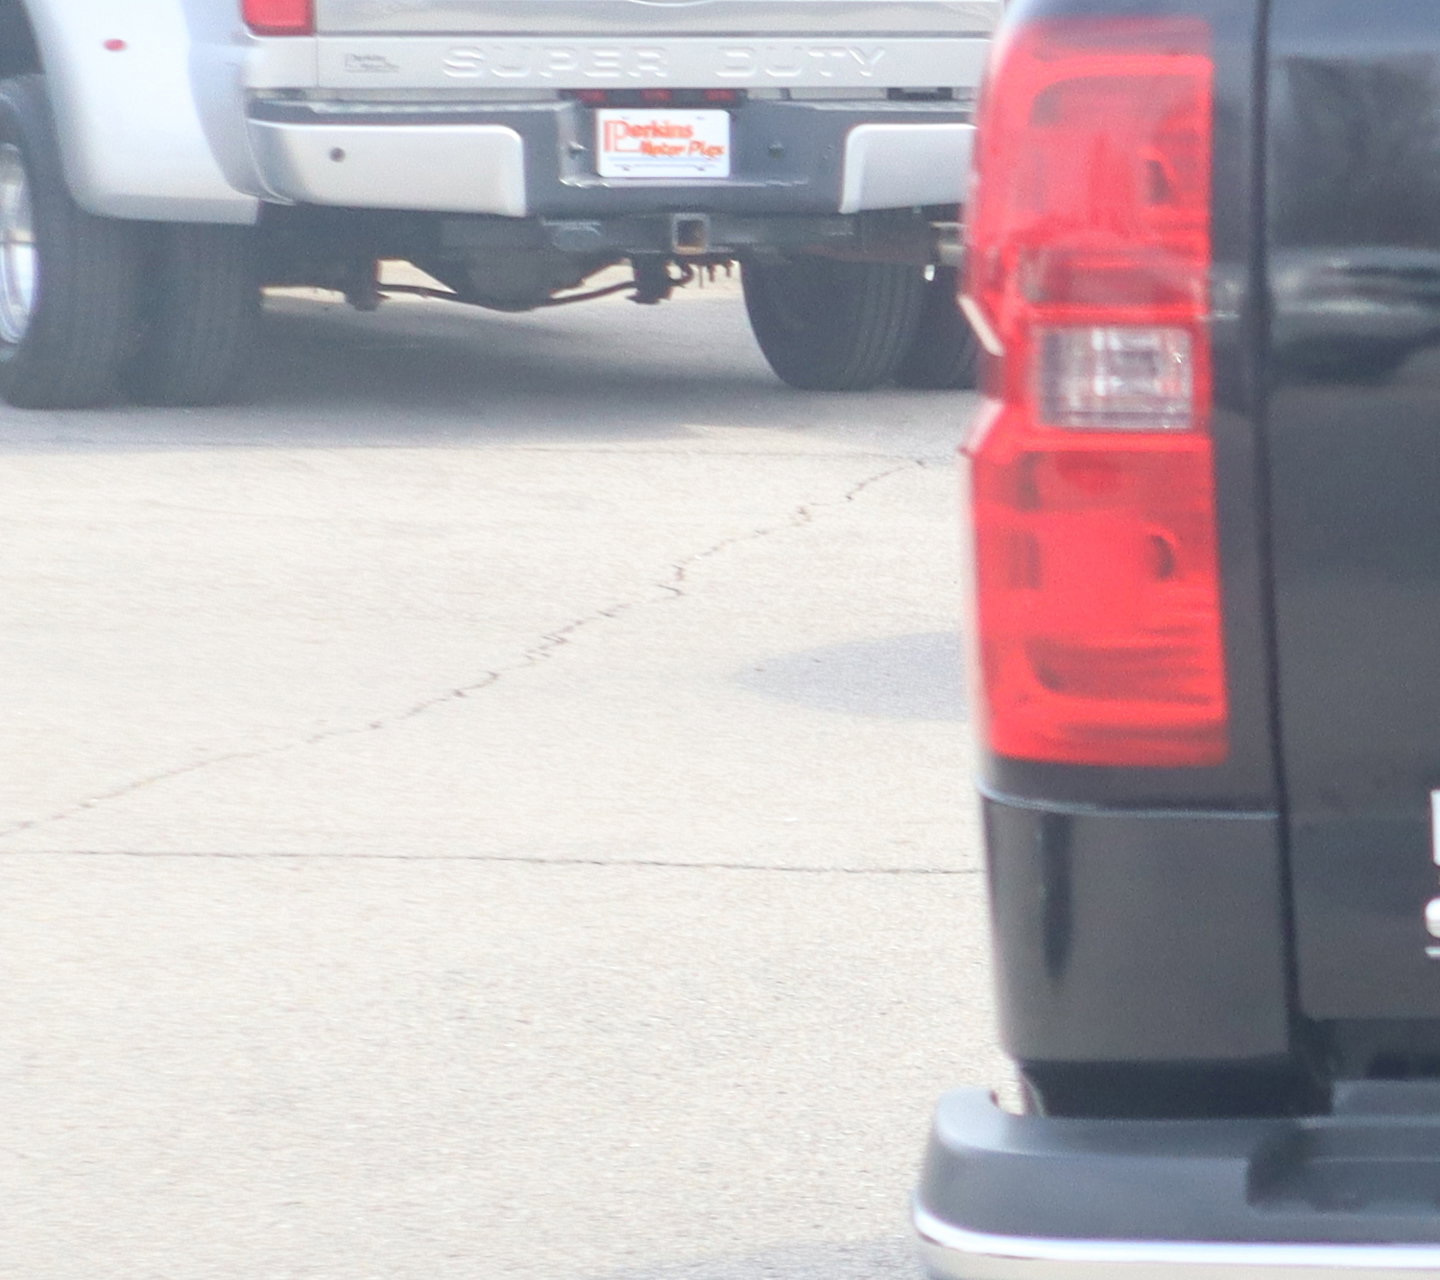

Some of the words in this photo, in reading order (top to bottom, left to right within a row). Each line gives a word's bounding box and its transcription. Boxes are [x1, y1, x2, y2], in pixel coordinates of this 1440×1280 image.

[441, 46, 671, 79] SUPER
[714, 45, 886, 79] DUTY
[603, 119, 695, 153] Perkins
